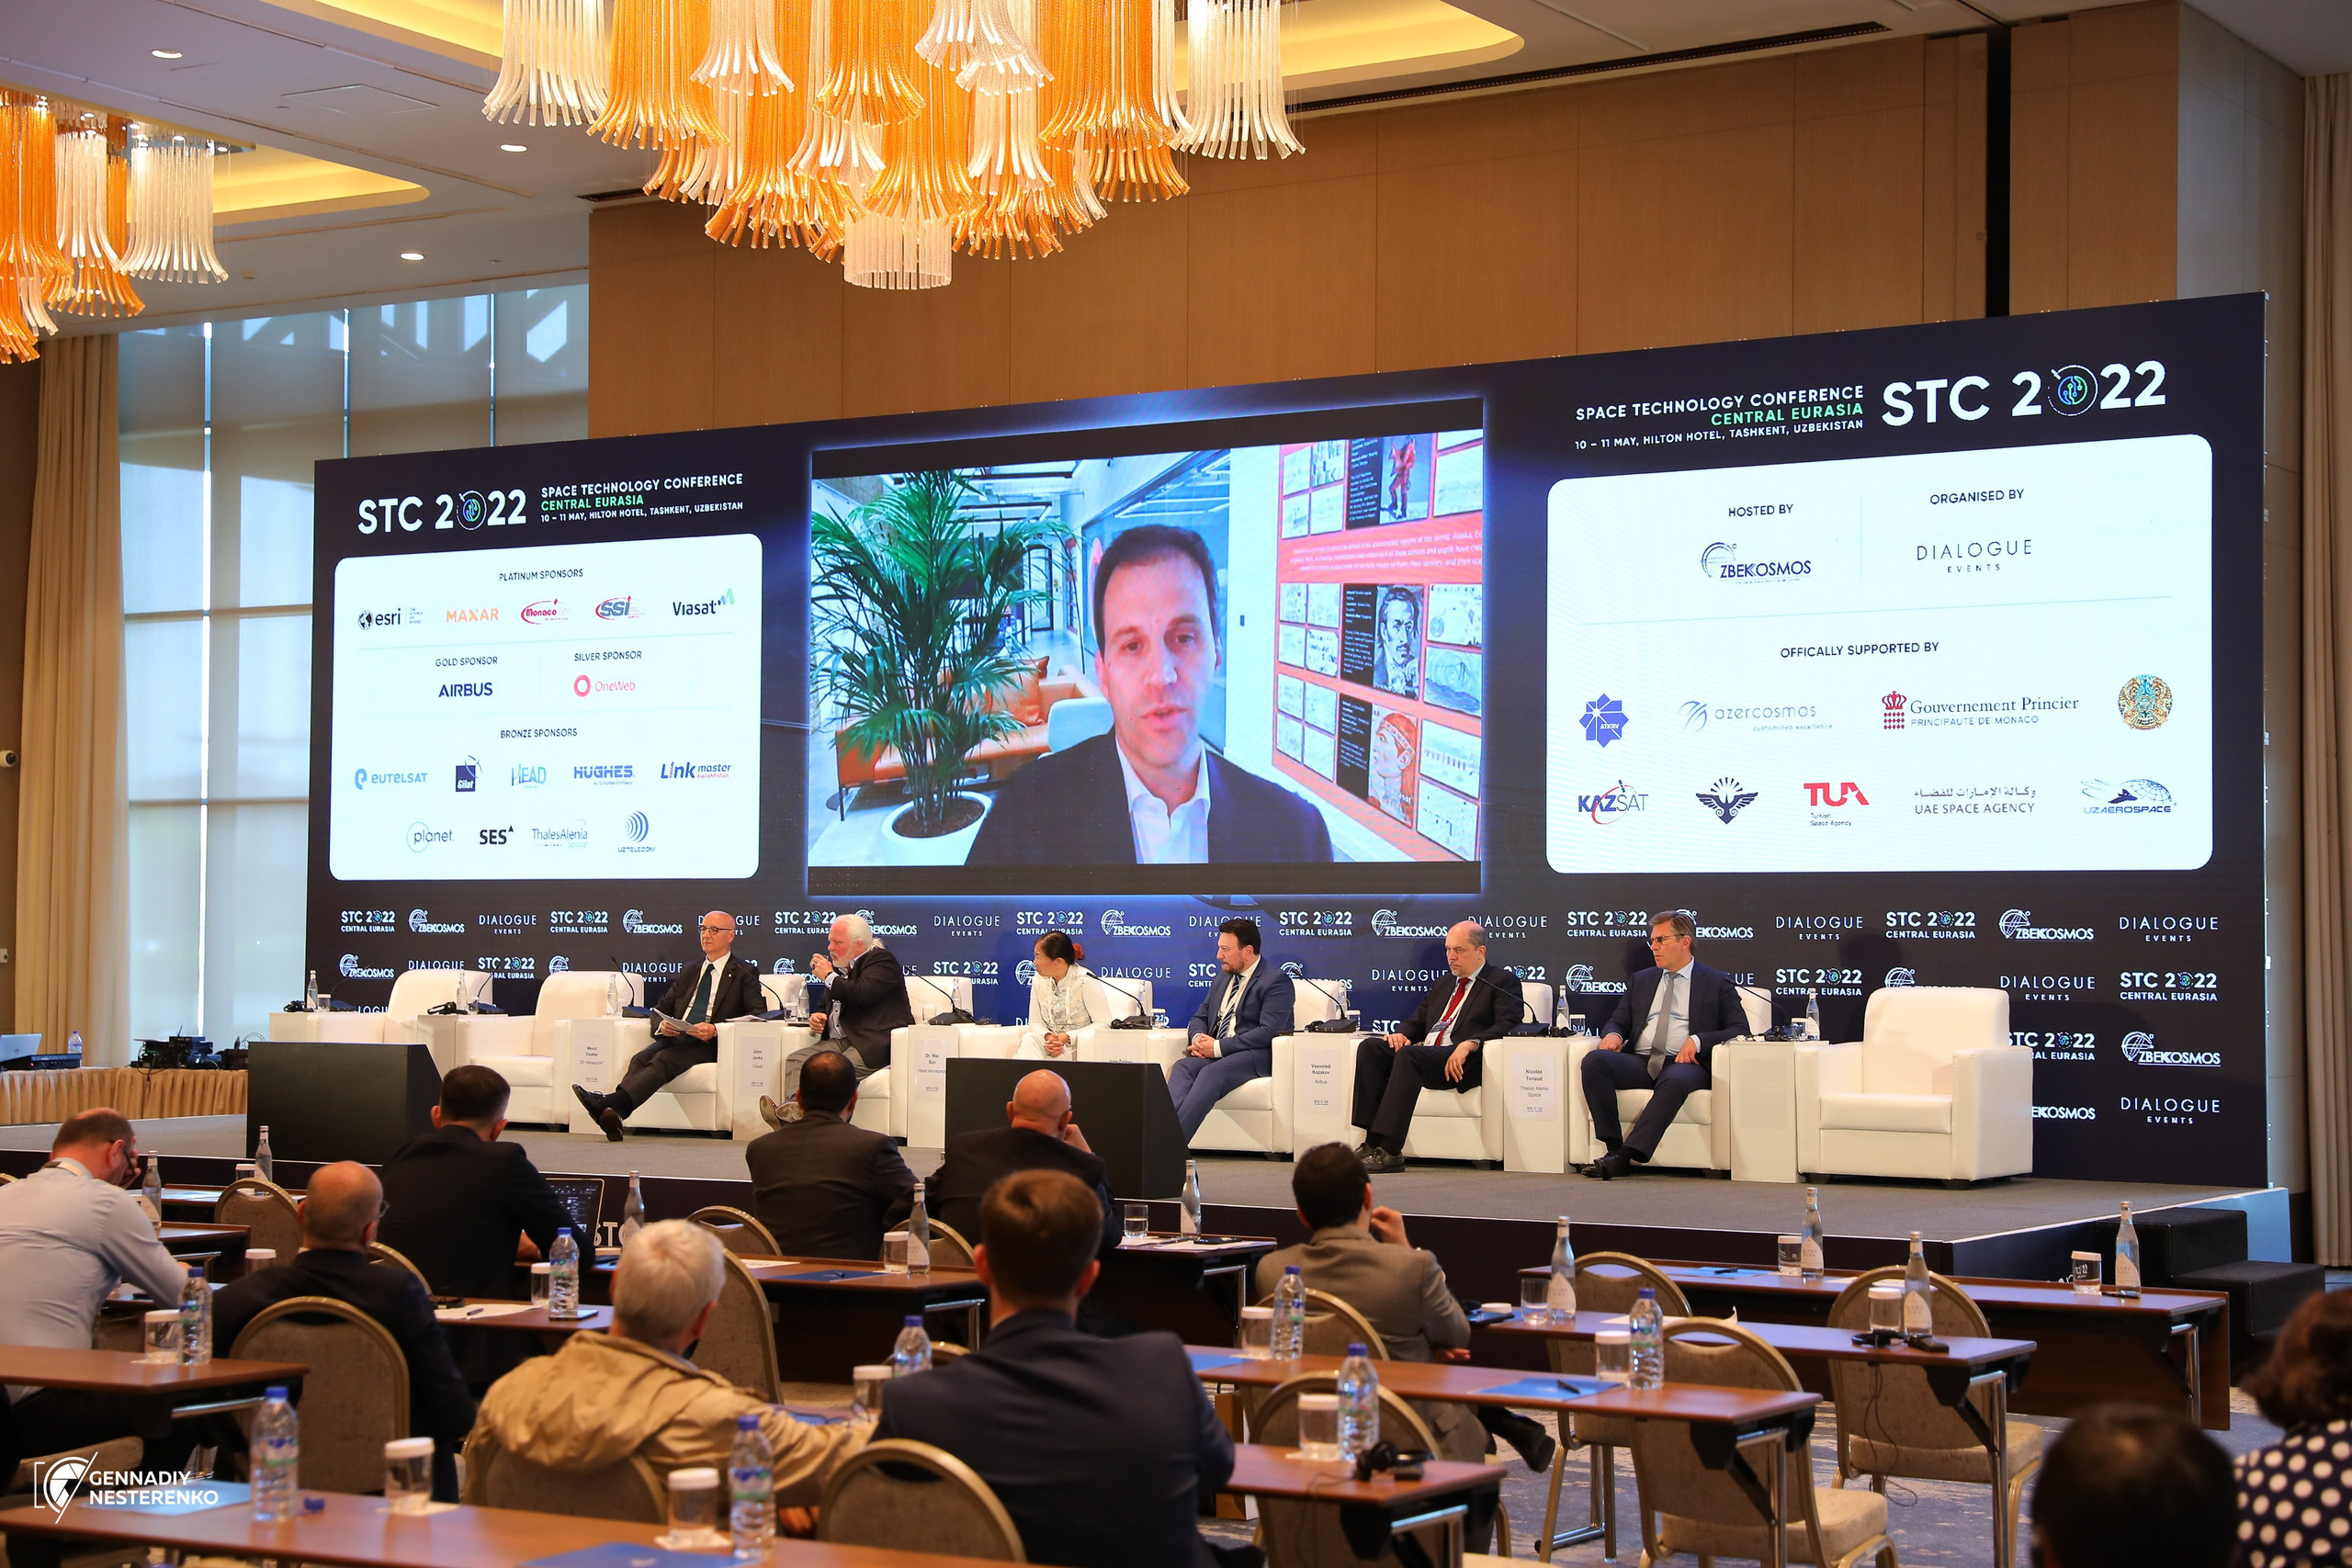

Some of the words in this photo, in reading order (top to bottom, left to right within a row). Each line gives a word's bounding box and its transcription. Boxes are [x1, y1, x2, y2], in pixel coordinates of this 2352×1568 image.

[1575, 402, 1628, 421] SPACE
[1633, 393, 1745, 416] TECHNOLOGY
[1749, 385, 1864, 407] CONFERENCE
[1882, 375, 1990, 427] STC
[1711, 406, 1785, 426] CENTRAL
[1790, 402, 1864, 421] EURASIA
[1575, 439, 1586, 449] 10
[1600, 438, 1610, 448] 11
[1613, 435, 1638, 449] MAY,
[1643, 432, 1681, 445] HILTON
[1685, 429, 1724, 443] HOTEL,
[1729, 423, 1790, 440] TASHKENT,
[1793, 419, 1864, 435] UZBEKISTAN
[541, 485, 578, 498] SPACE
[581, 479, 660, 495] TECHNOLOGY
[663, 473, 742, 490] CONFERENCE
[541, 497, 592, 512] CENTRAL
[594, 494, 644, 507] EURASIA
[1929, 491, 2004, 505] ORGANISED
[2007, 489, 2024, 502] BY
[357, 495, 423, 535] STC
[540, 514, 549, 523] 10
[560, 513, 566, 522] 11
[568, 513, 587, 522] MAY,
[589, 510, 616, 520] HILTON
[619, 508, 648, 518] HOTEL,
[650, 505, 692, 516] TASHKENT,
[694, 502, 743, 513] UZBEKISTAN
[1728, 505, 1774, 518] HOSTED
[1778, 504, 1793, 516] BY
[1917, 539, 2032, 560] DIALOGUE
[499, 570, 537, 581] PLATINUM
[540, 569, 583, 579] SPONSORS
[1947, 563, 2001, 573] EVENTS
[673, 599, 716, 616] Viasat
[375, 608, 401, 626] esri
[447, 608, 499, 623] MAXAR
[574, 653, 600, 662] SILVER
[603, 650, 641, 660] SPONSOR
[1781, 644, 1842, 660] OFFICALLY
[1847, 642, 1919, 656] SUPPORTED
[1924, 641, 1939, 653] BY
[435, 658, 458, 667] GOLD
[460, 656, 498, 666] SPONSOR
[438, 682, 492, 698] AIRBUS
[594, 680, 636, 693] OneWeb
[1714, 704, 1817, 720] azercosmos
[1910, 697, 2016, 714] Gouvernement
[2020, 695, 2078, 710] Princier
[1978, 715, 1990, 725] DE
[1994, 714, 2039, 725] MONACO
[501, 728, 531, 739] BRONZE
[534, 728, 578, 738] SPONSORS
[662, 761, 695, 780] Link
[458, 779, 474, 789] Gilat
[1578, 791, 1648, 812] KAZSAT
[1915, 802, 1938, 814] UAE
[1942, 802, 1979, 814] SPACE
[1984, 801, 2035, 814] AGENCY
[480, 830, 507, 845] SES
[341, 910, 362, 923] STC
[479, 915, 537, 925] DIALOGUE
[550, 910, 573, 923] STC
[775, 911, 799, 924] STC
[933, 915, 1000, 927] DIALOGUE
[1016, 911, 1043, 925] STC
[1279, 911, 1308, 925] STC
[1566, 911, 1599, 926] STC
[1776, 916, 1863, 929] DIALOGUE
[1886, 911, 1921, 926] STC
[2120, 917, 2219, 931] DIALOGUE
[933, 962, 959, 975] STC
[1101, 967, 1171, 978] DIALOGUE
[1188, 964, 1217, 976] STC
[1776, 969, 1810, 984] STC
[2000, 976, 2096, 989] DIALOGUE
[2120, 973, 2158, 988] STC
[2120, 992, 2167, 1000] CENTRAL
[2170, 992, 2218, 1001] EURASIA
[2120, 1097, 2221, 1113] DIALOGUE
